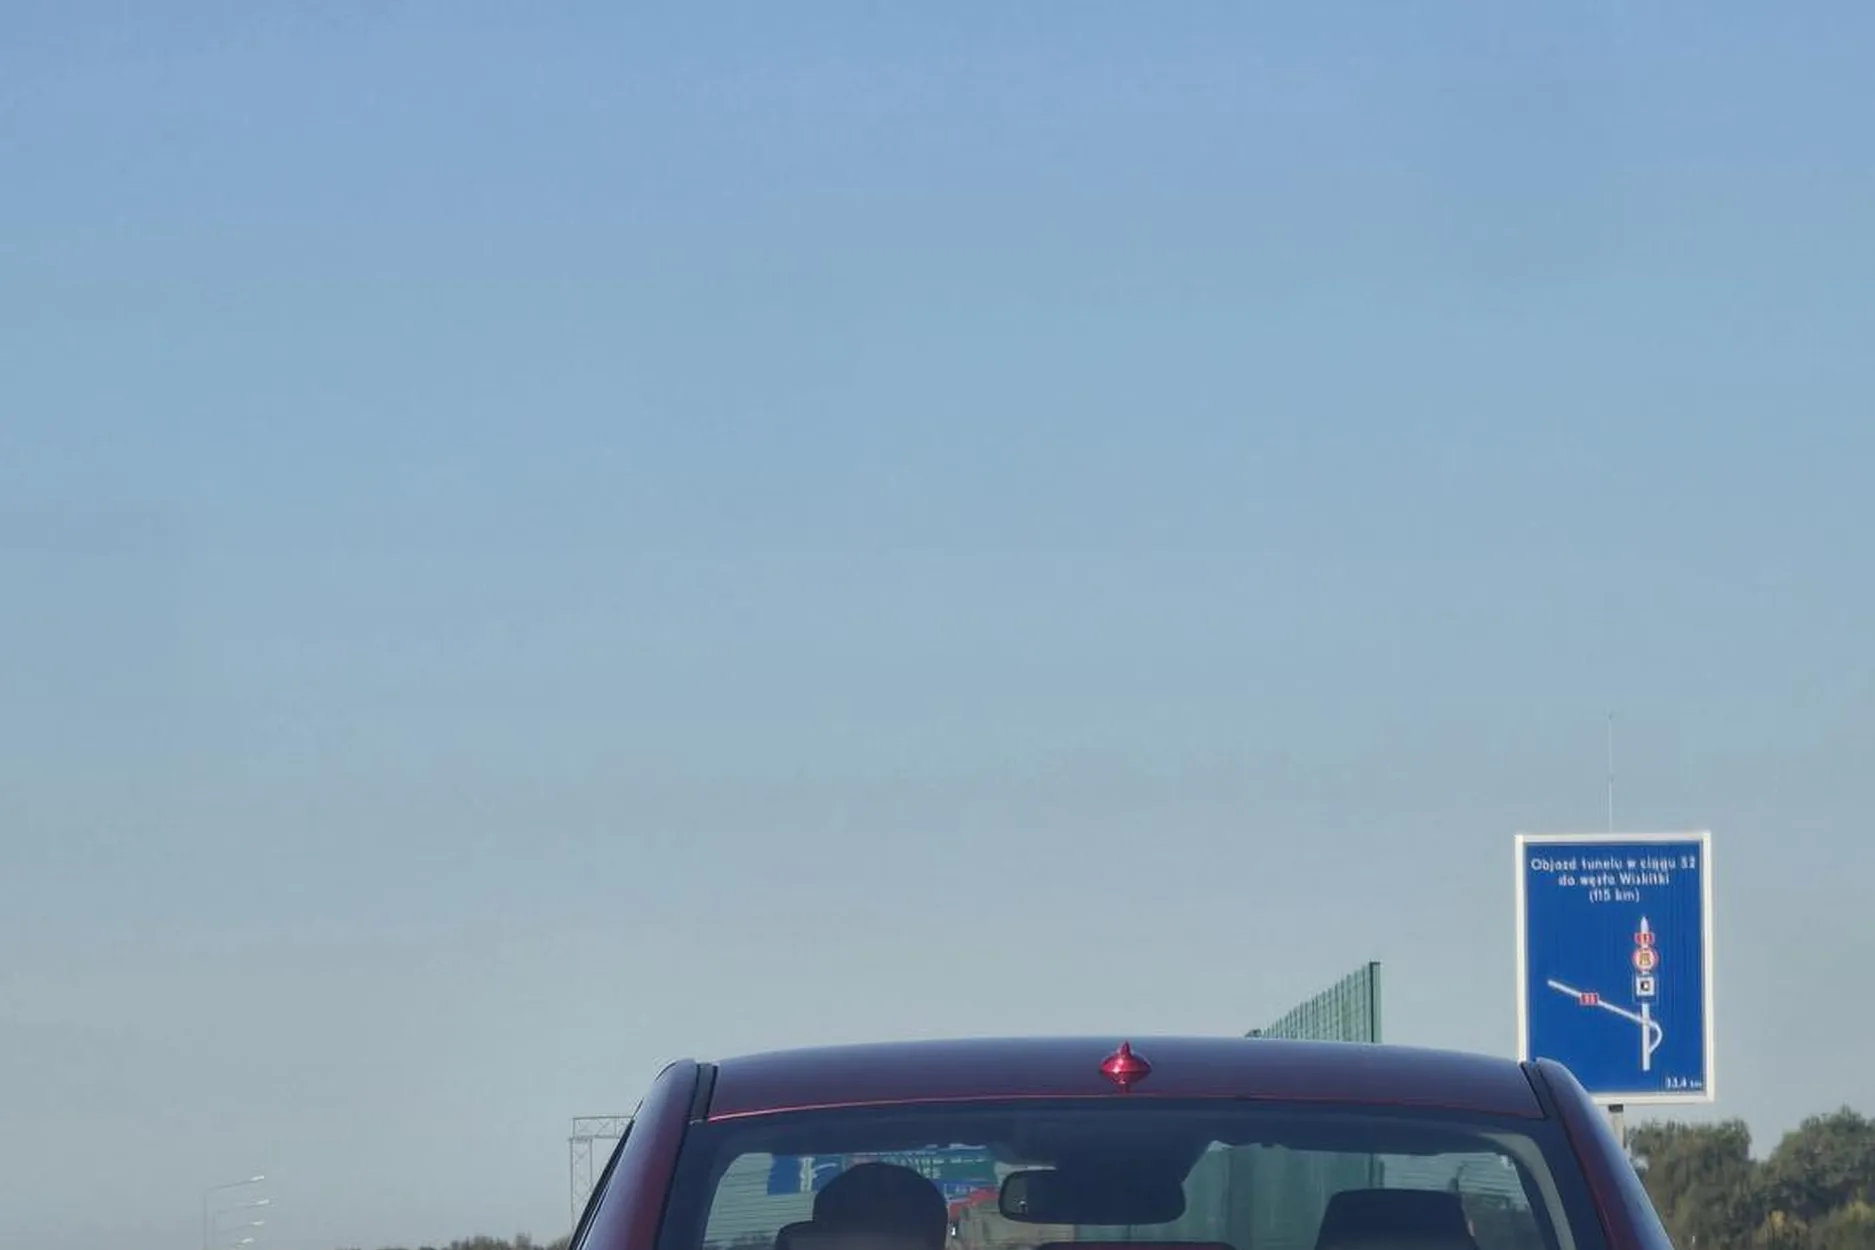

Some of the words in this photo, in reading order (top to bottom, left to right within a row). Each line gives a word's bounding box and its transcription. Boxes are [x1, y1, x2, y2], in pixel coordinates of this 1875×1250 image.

[1627, 859, 1636, 869] w
[1558, 874, 1575, 886] do
[1615, 887, 1640, 903] km)
